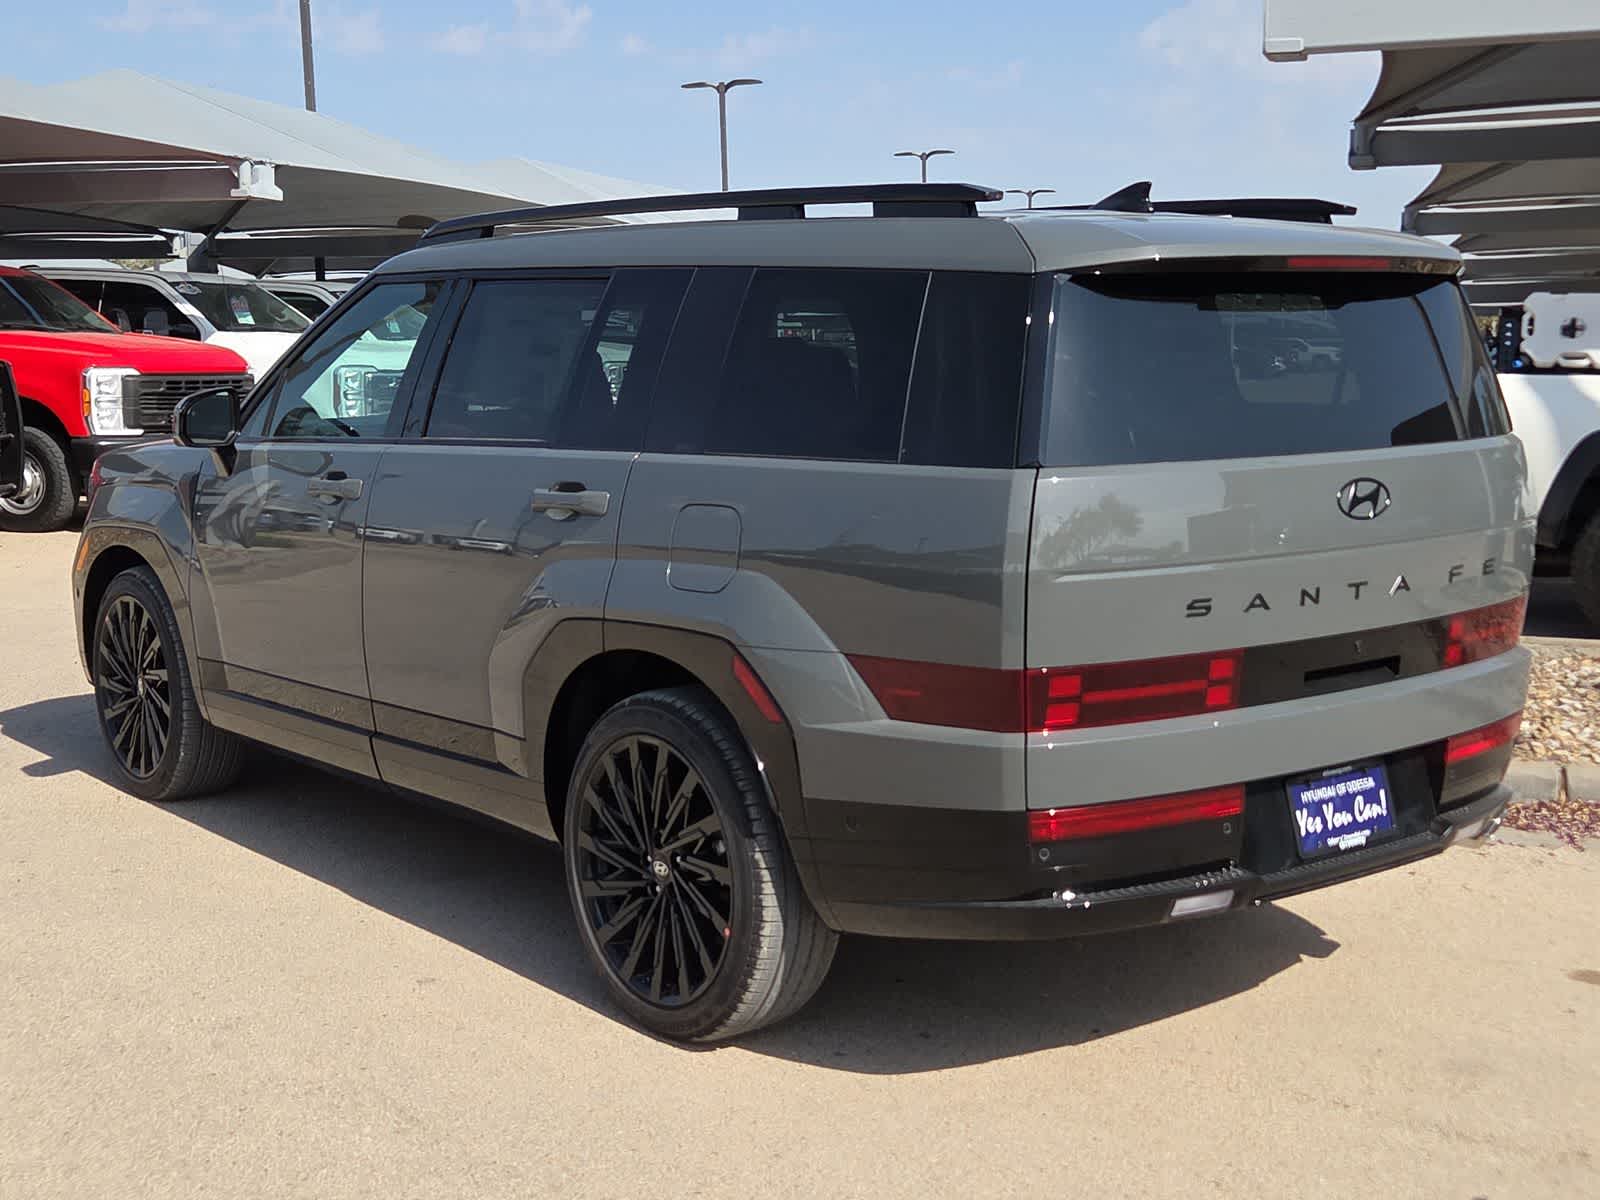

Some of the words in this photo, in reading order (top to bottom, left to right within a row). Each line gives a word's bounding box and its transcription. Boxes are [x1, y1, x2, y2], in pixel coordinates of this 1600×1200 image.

[1185, 575, 1411, 618] SANTA
[1447, 557, 1495, 584] FE
[1296, 807, 1323, 837] Yes
[1322, 802, 1353, 831] You
[1354, 789, 1387, 823] Can!
[1301, 785, 1336, 804] HYUNDAI
[1336, 783, 1346, 796] OF
[1346, 777, 1376, 794] ODESSA
